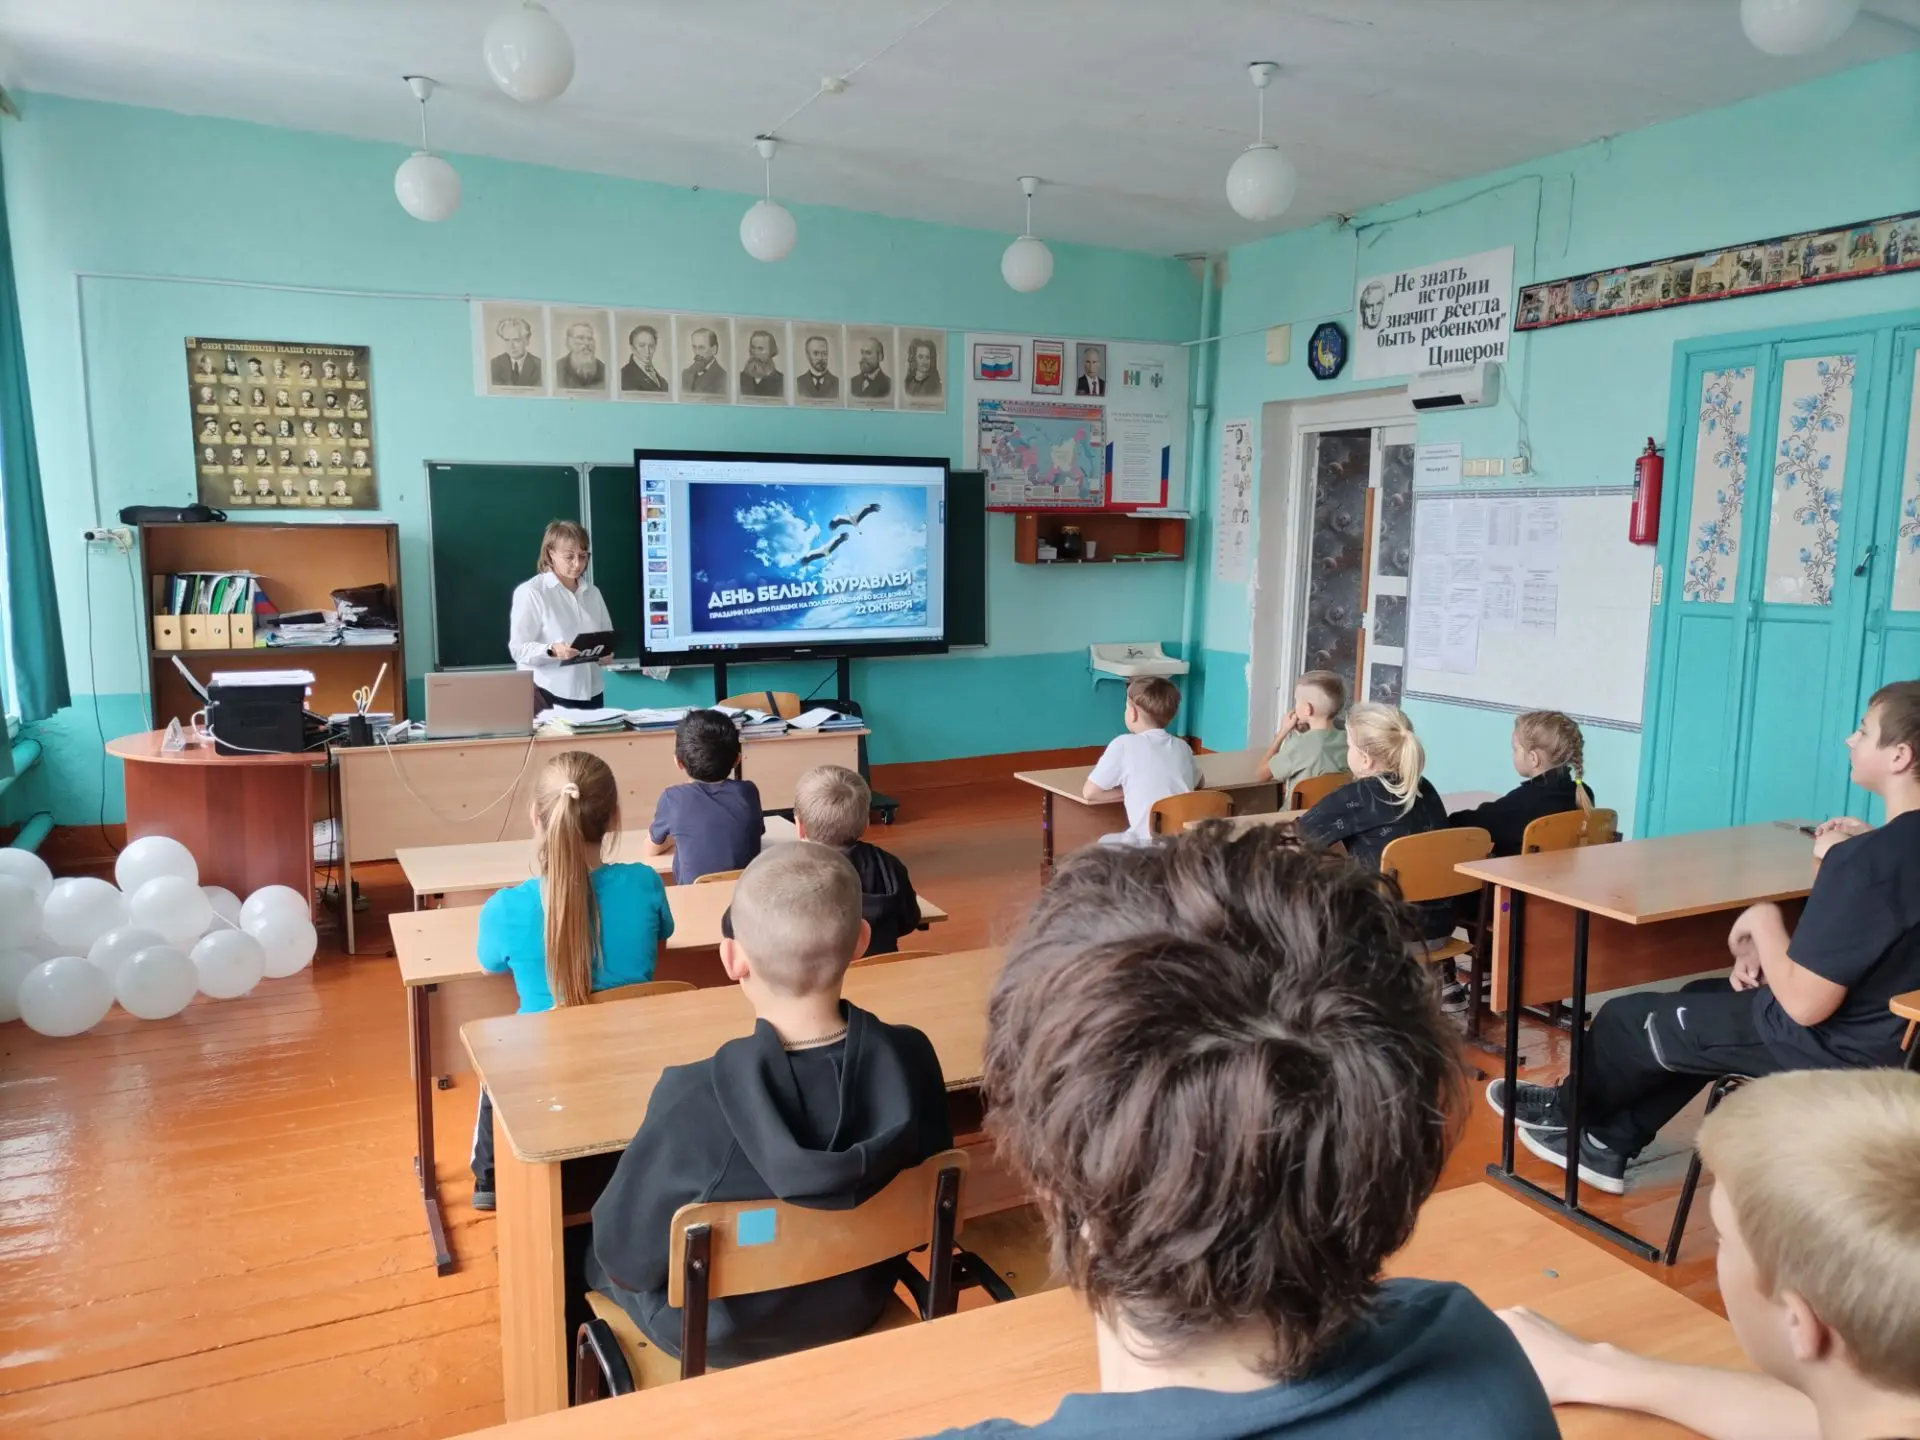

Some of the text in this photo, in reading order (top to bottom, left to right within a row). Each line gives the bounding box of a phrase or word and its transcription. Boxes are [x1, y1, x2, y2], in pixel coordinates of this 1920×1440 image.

[1420, 266, 1467, 288] знать
[1418, 279, 1490, 305] истории
[1385, 297, 1500, 329] значит всегда
[201, 342, 222, 350] ОНИ
[1377, 329, 1416, 348] быть
[1428, 341, 1504, 368] Цицерон
[707, 570, 913, 609] ДЕНЬ БЕЛЫХ ЖУРАВЛЕЙ
[744, 606, 770, 616] ПАМЯТИ
[771, 603, 799, 613] ПАВШИХ
[855, 599, 913, 615] 22 ОКТЯБРЯ
